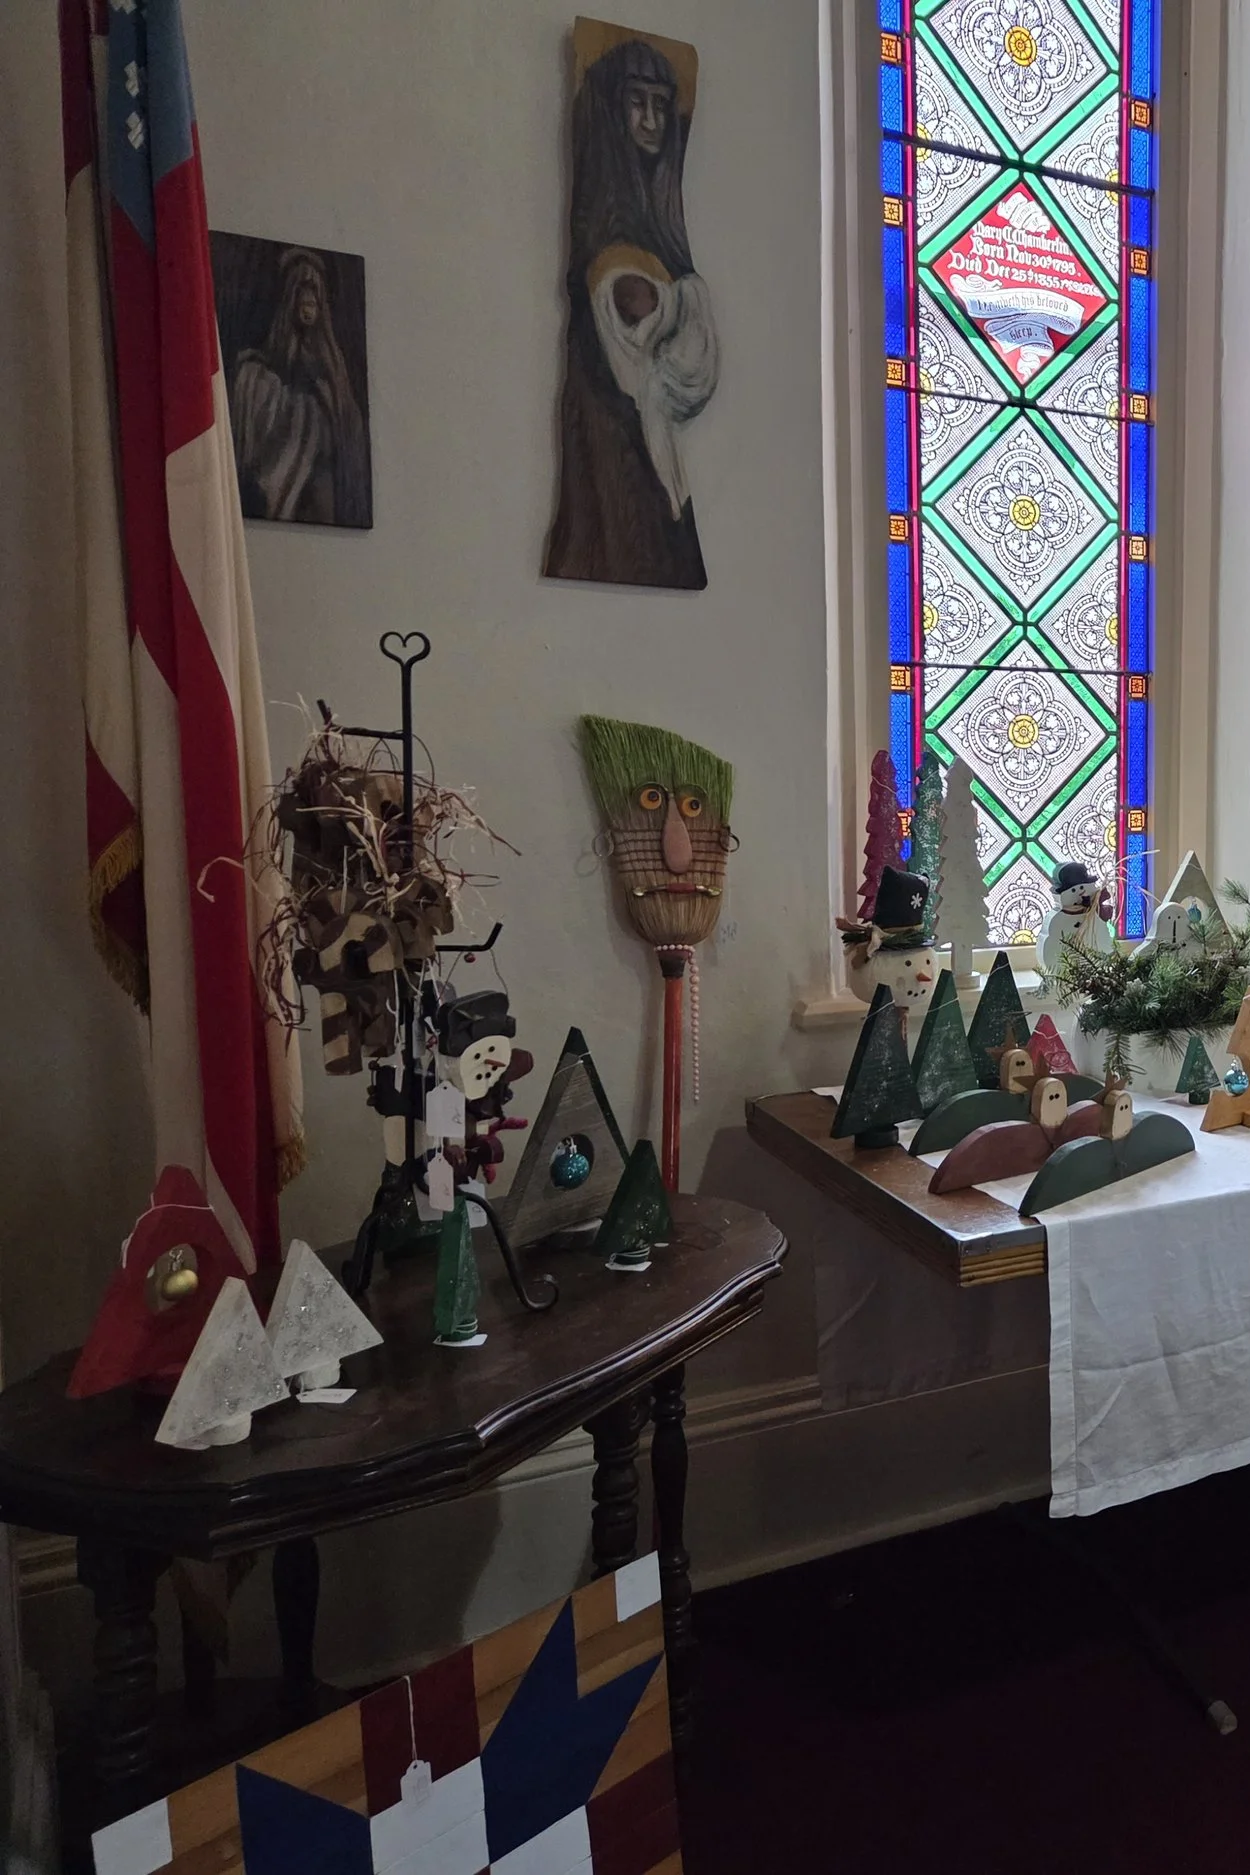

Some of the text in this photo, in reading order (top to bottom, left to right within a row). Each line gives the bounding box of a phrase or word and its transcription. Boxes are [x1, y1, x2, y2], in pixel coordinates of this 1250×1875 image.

[969, 235, 1004, 259] Born
[947, 249, 982, 272] Died
[985, 258, 1011, 279] Dec
